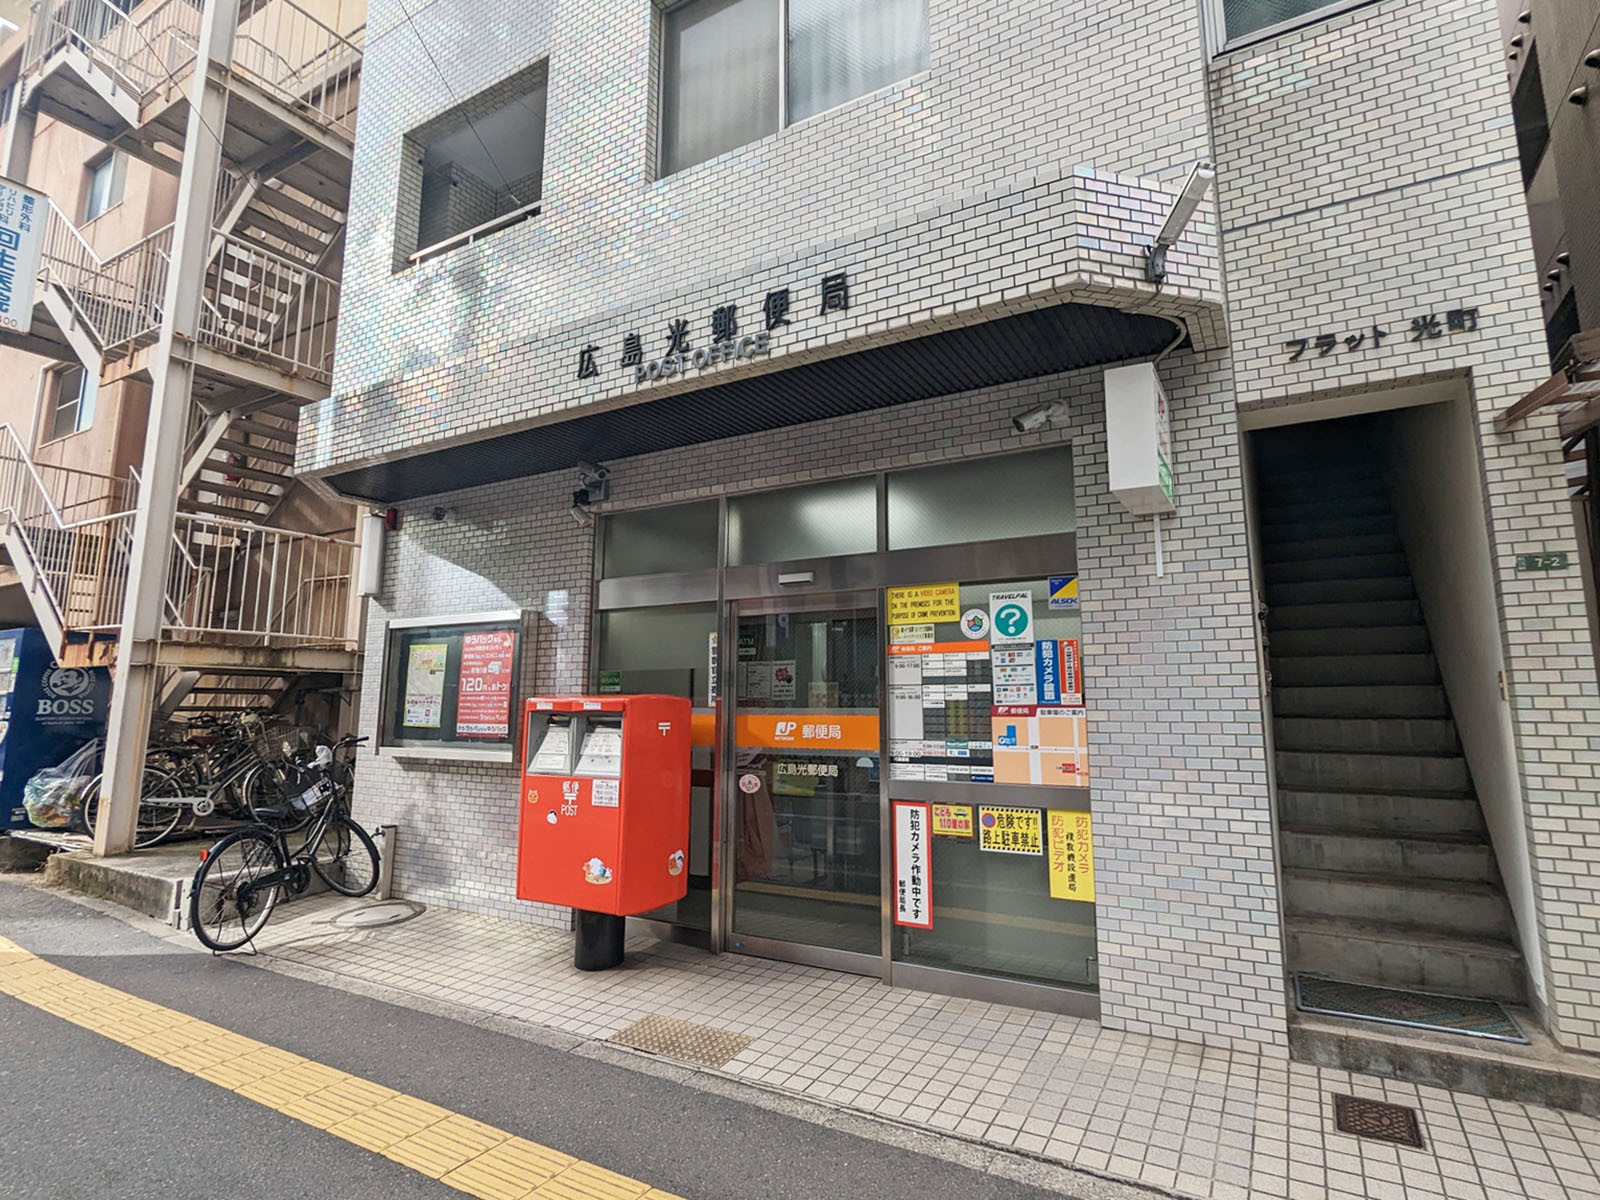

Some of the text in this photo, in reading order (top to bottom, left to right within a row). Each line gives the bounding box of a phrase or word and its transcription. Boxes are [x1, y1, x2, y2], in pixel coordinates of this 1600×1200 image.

[577, 271, 849, 379] 広島光郵便局
[634, 331, 770, 384] POST OFFICE
[1535, 556, 1561, 567] 7-2
[891, 591, 905, 599] THERE
[935, 588, 955, 596] CAMERA
[992, 592, 1028, 600] TRAVELPAL
[933, 599, 942, 607] FOR
[930, 609, 956, 617] PREVENTION
[36, 699, 94, 715] BOSS
[802, 724, 842, 740] 郵便局
[777, 763, 839, 778] 広島光郵便局
[562, 781, 579, 794] 郵便
[561, 804, 578, 816] POST
[934, 807, 951, 817] こども
[983, 829, 1040, 848] 路上駐車禁止
[1051, 815, 1065, 872] 防犯ビデオ
[1075, 816, 1089, 874] 防犯カメラ
[910, 808, 921, 920] 防犯カメラ作動中です
